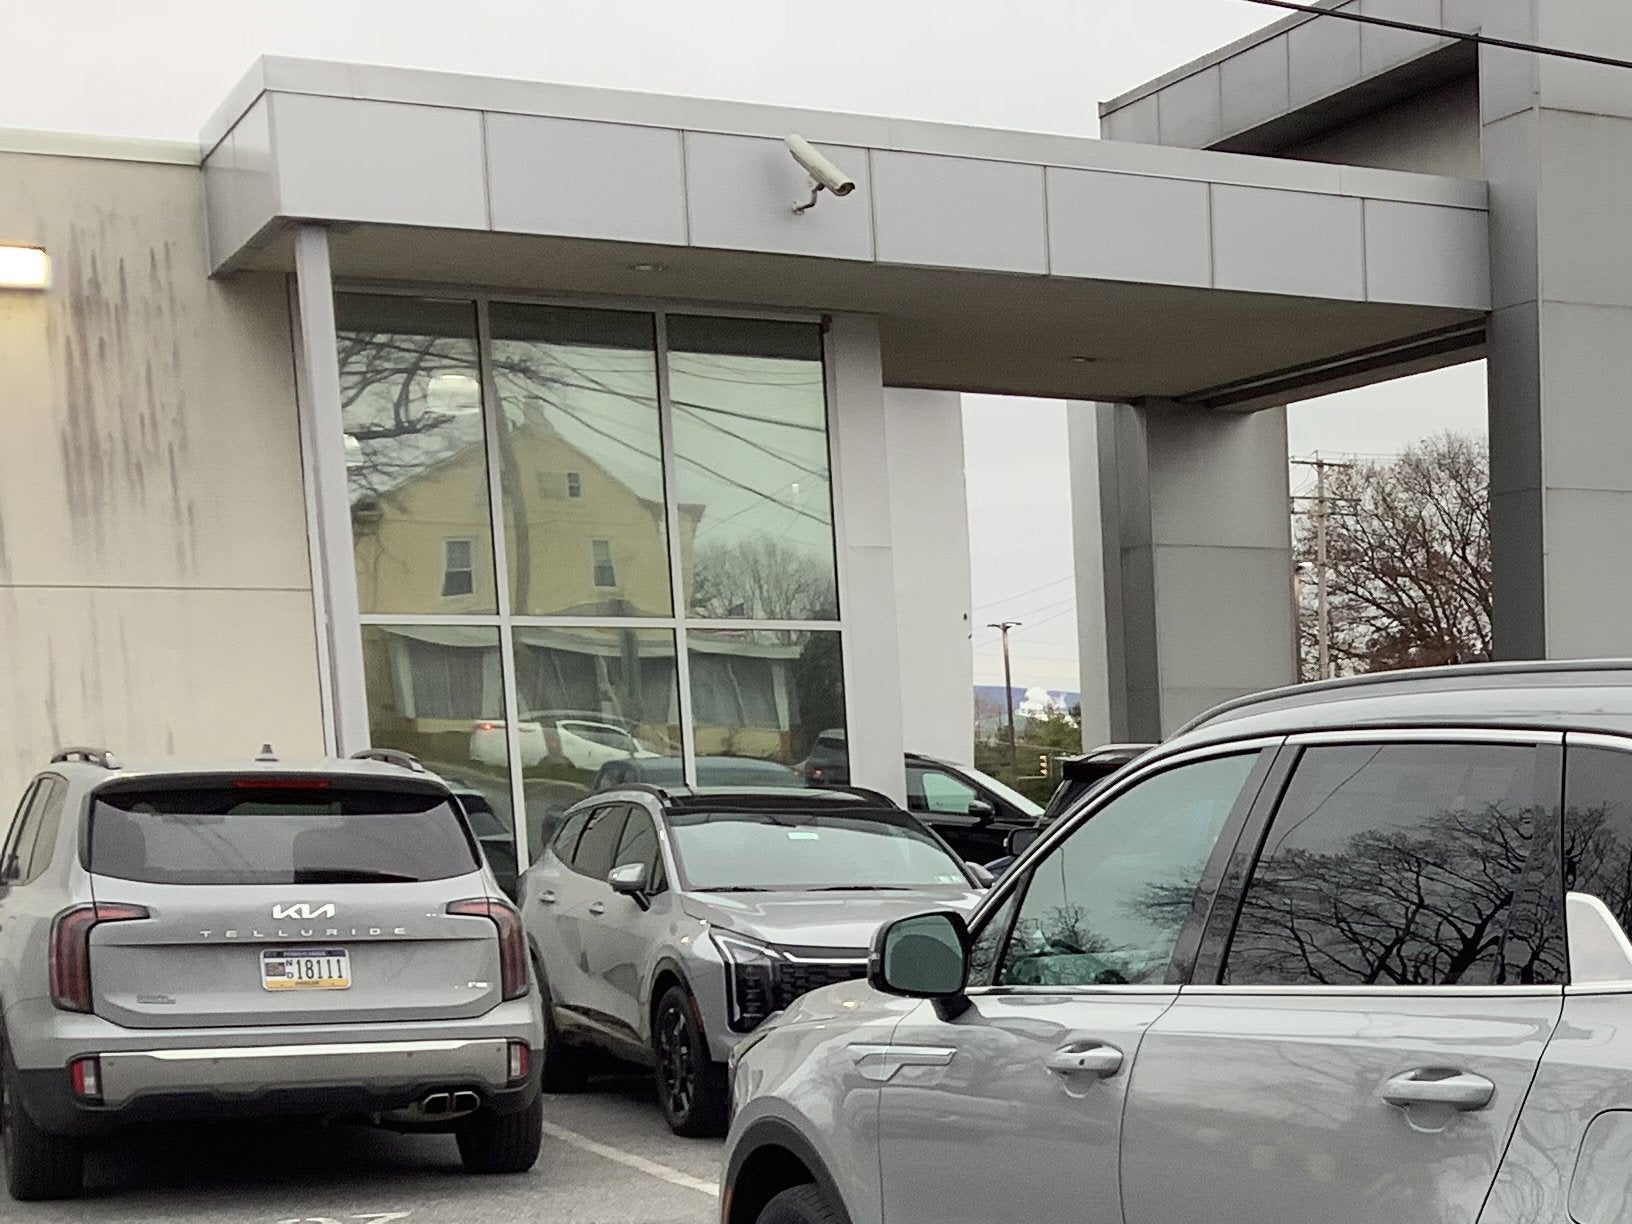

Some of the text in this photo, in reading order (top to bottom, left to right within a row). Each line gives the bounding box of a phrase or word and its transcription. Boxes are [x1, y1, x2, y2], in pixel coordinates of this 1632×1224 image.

[272, 903, 336, 919] KIA
[200, 927, 406, 938] TELLURIDE
[296, 959, 343, 979] 18111
